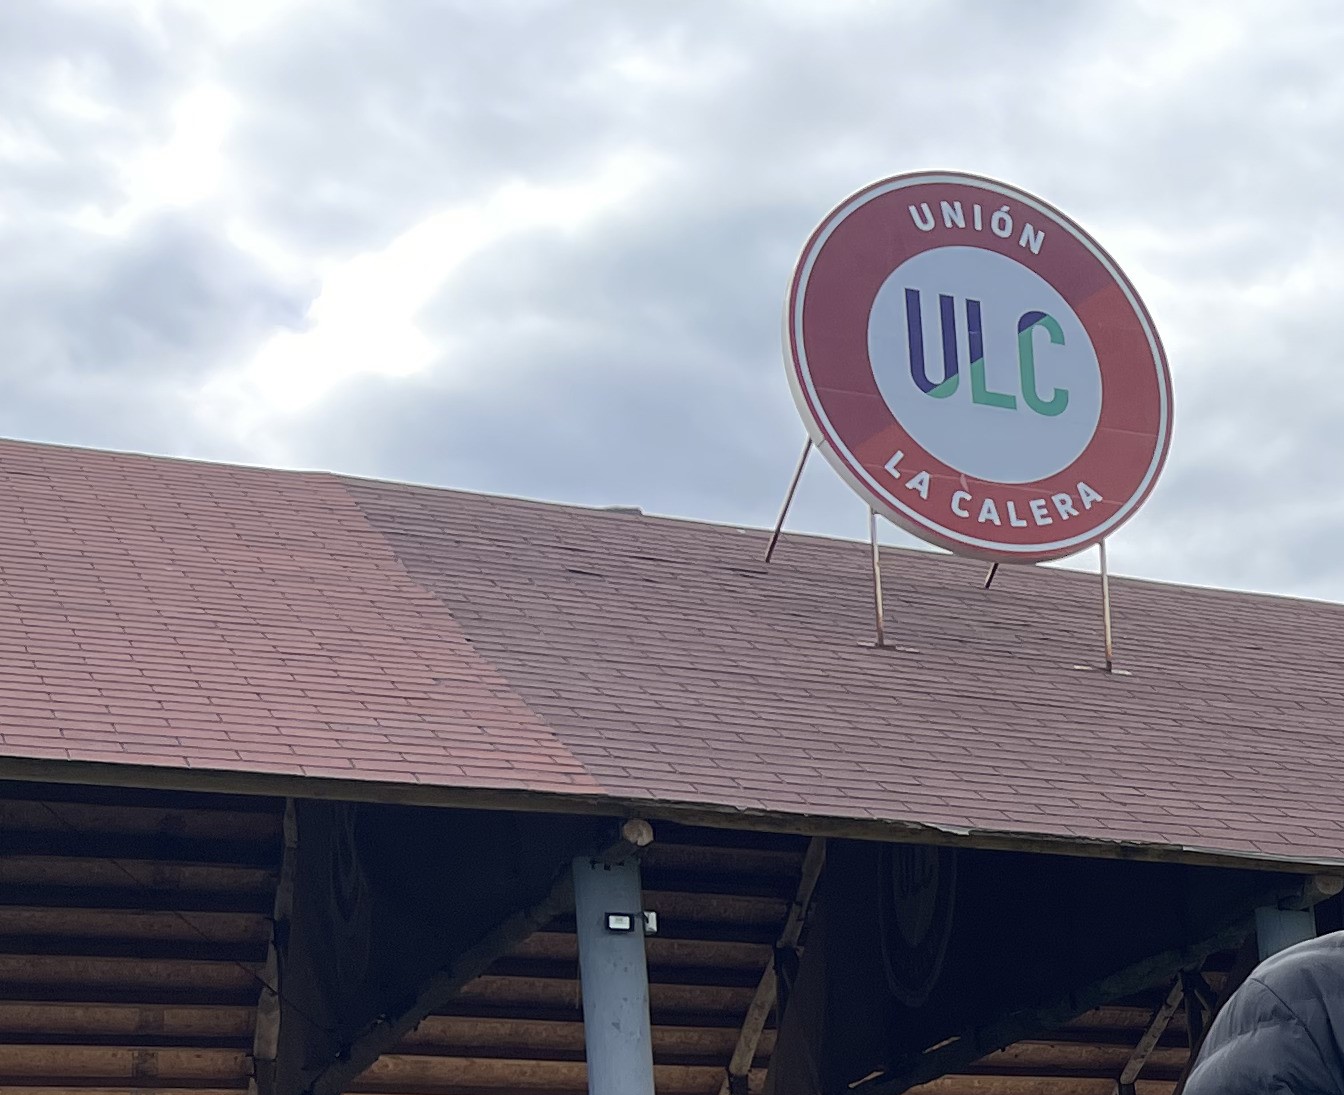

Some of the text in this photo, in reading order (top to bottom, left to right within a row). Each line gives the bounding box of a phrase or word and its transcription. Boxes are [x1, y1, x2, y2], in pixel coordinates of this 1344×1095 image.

[907, 201, 1046, 255] UNIÓN
[904, 287, 1069, 417] ULC
[884, 450, 1104, 528] LA CALERA
